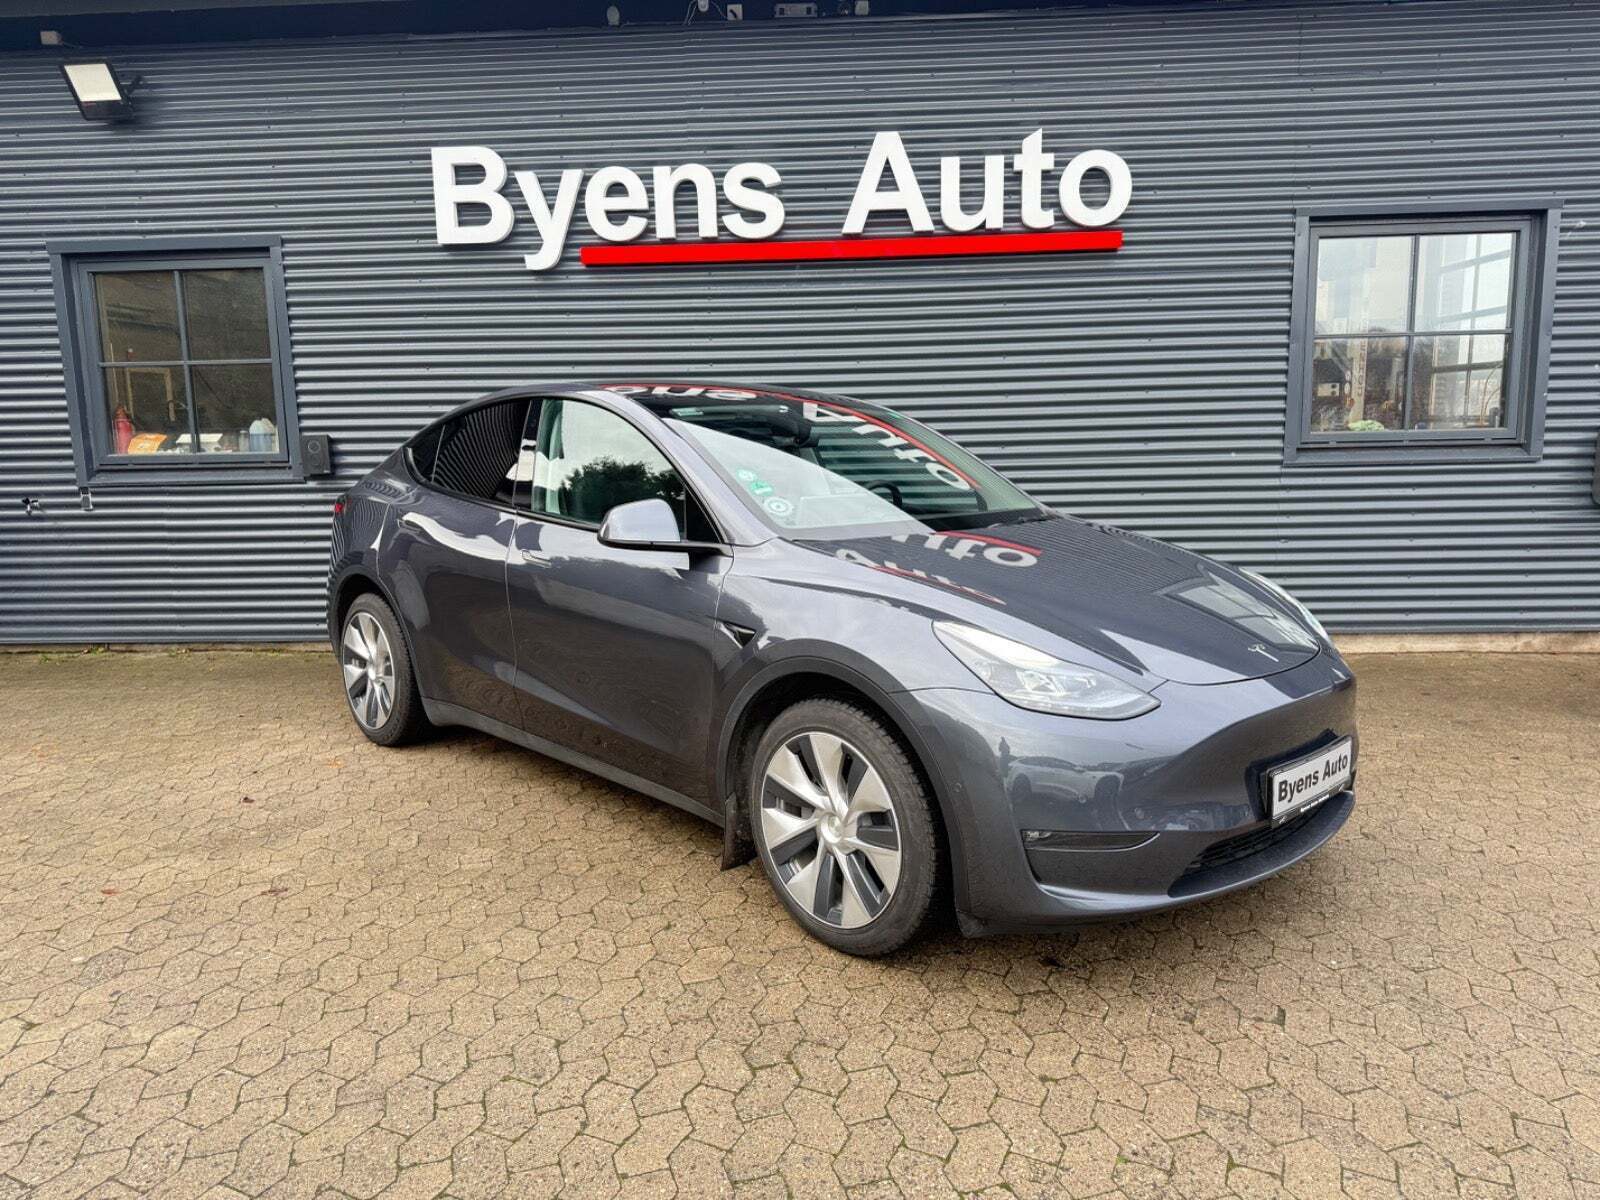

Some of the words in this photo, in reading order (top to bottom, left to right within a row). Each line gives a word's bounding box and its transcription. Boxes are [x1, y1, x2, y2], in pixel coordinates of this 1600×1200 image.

[431, 146, 786, 271] Byens
[841, 127, 1133, 234] Auto
[1277, 770, 1319, 803] Byens
[1322, 753, 1349, 781] Auto
